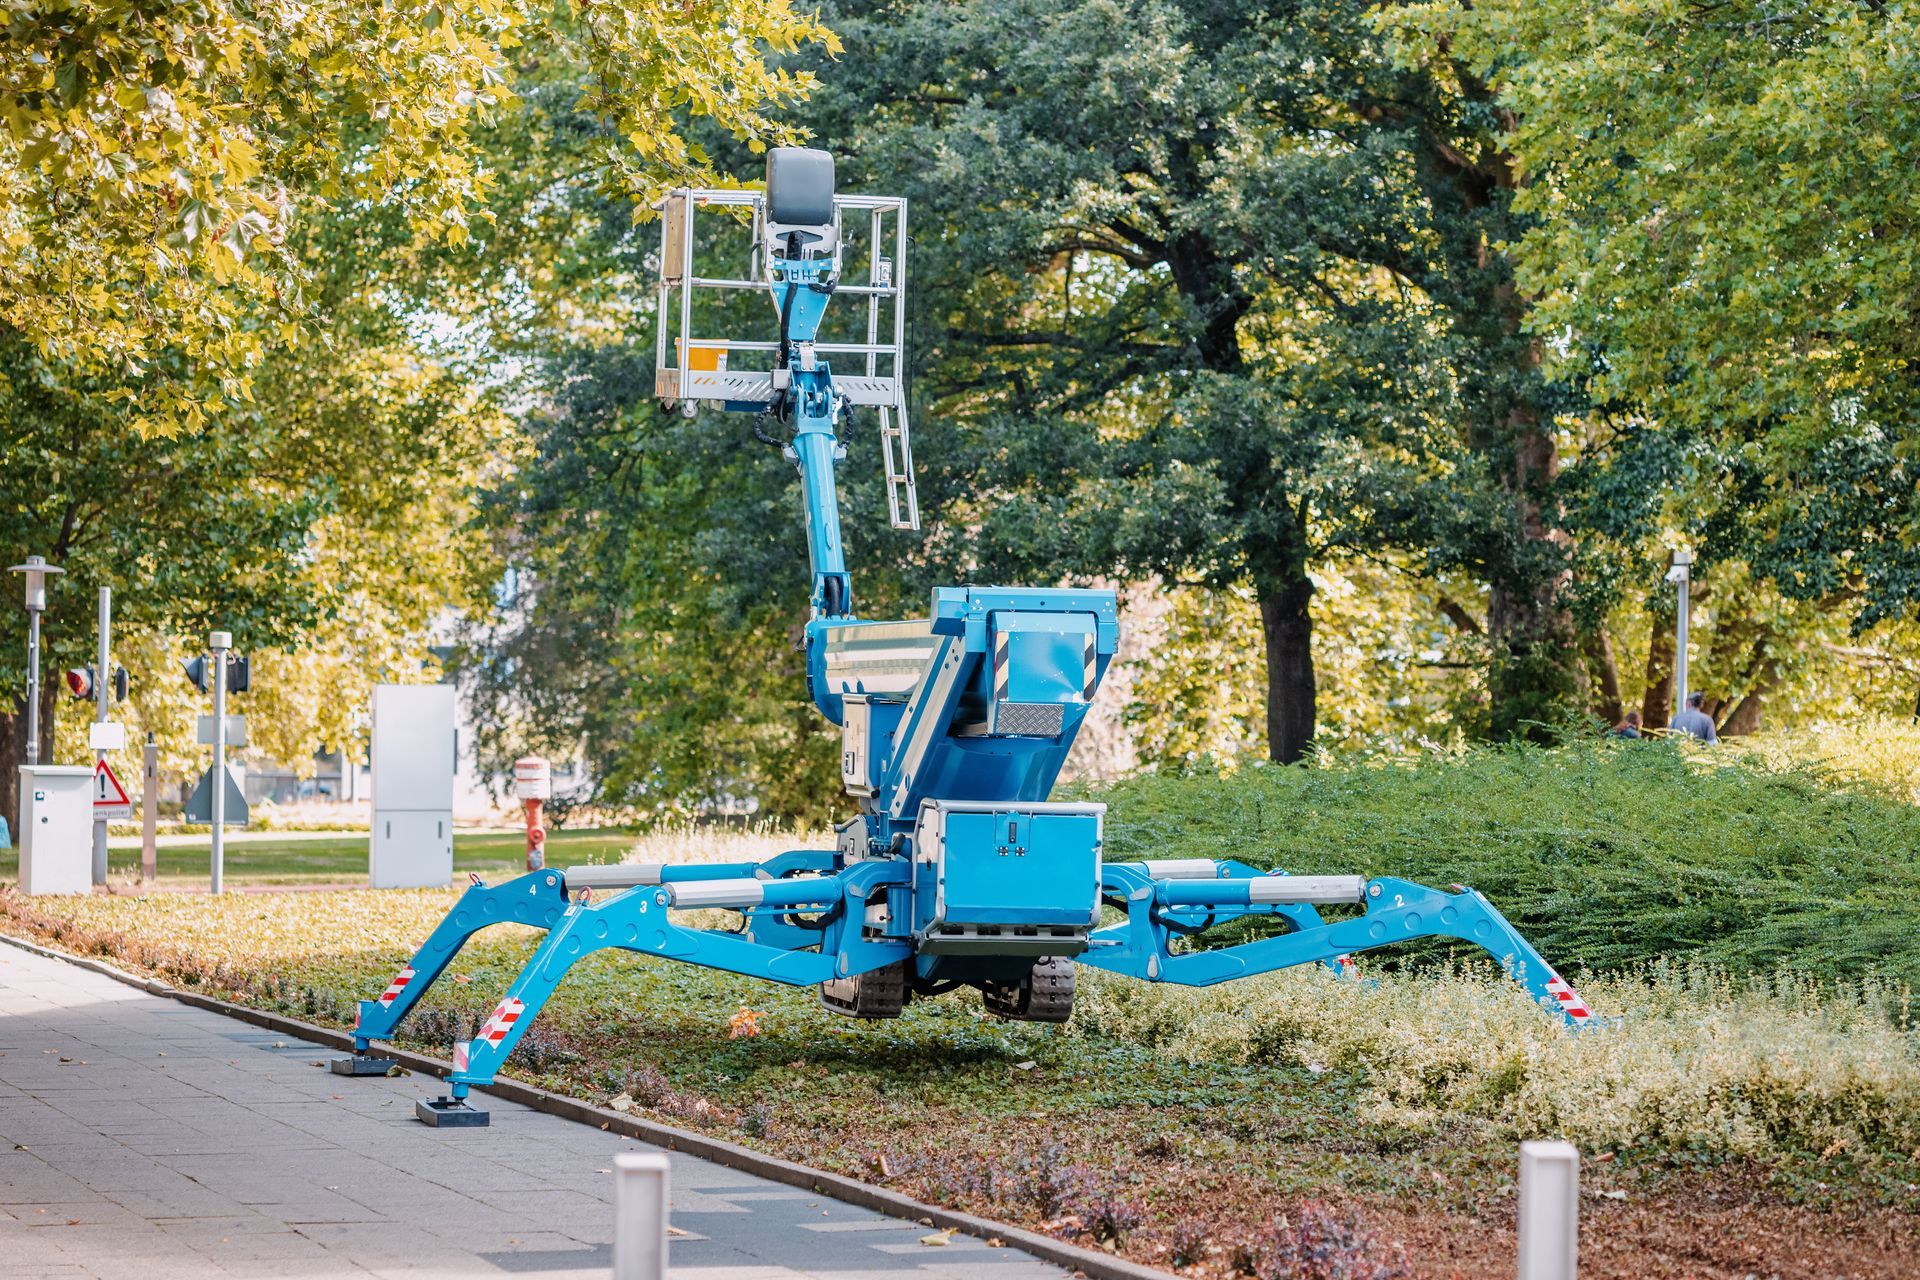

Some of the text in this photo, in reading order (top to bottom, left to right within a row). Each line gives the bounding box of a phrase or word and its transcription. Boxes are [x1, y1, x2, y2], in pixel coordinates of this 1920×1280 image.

[529, 884, 537, 895] 4
[639, 900, 648, 913] 3
[1394, 894, 1404, 907] 2
